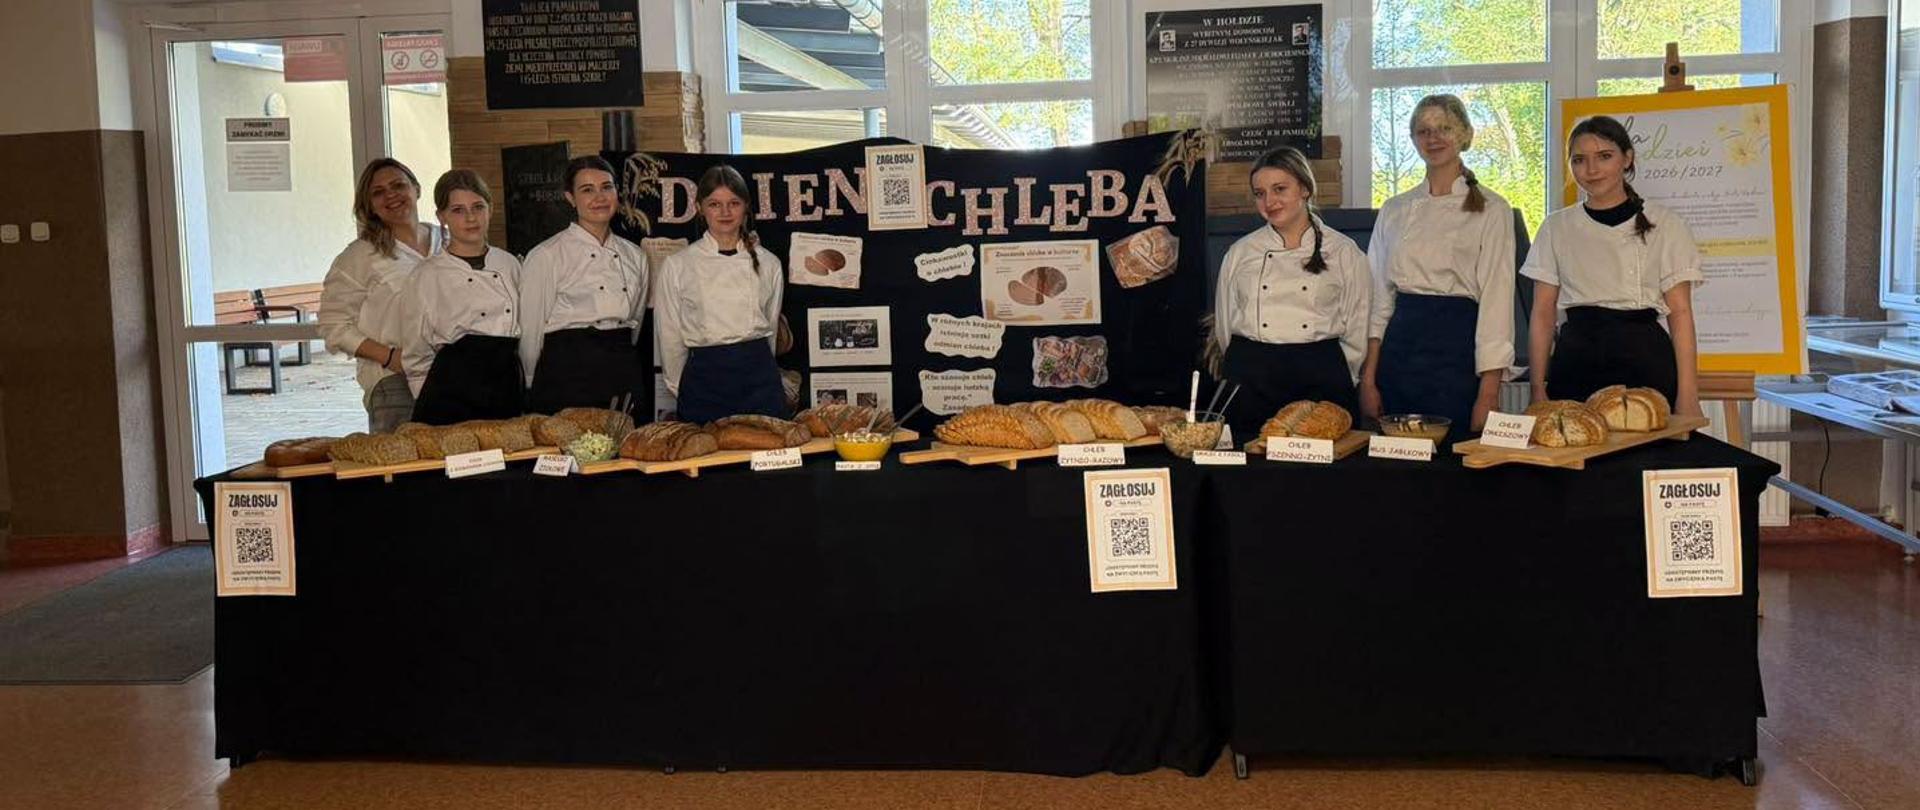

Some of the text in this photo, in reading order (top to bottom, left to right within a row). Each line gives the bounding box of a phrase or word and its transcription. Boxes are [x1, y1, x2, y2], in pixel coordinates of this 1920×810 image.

[1203, 18, 1212, 27] W
[876, 153, 914, 165] ZAGŁOSUJ
[927, 169, 1176, 236] CHLEBA
[1100, 482, 1156, 498] ZAGŁOSUJ
[1659, 483, 1721, 499] ZAGŁOSUJ
[228, 494, 278, 508] ZAGŁOSUJ
